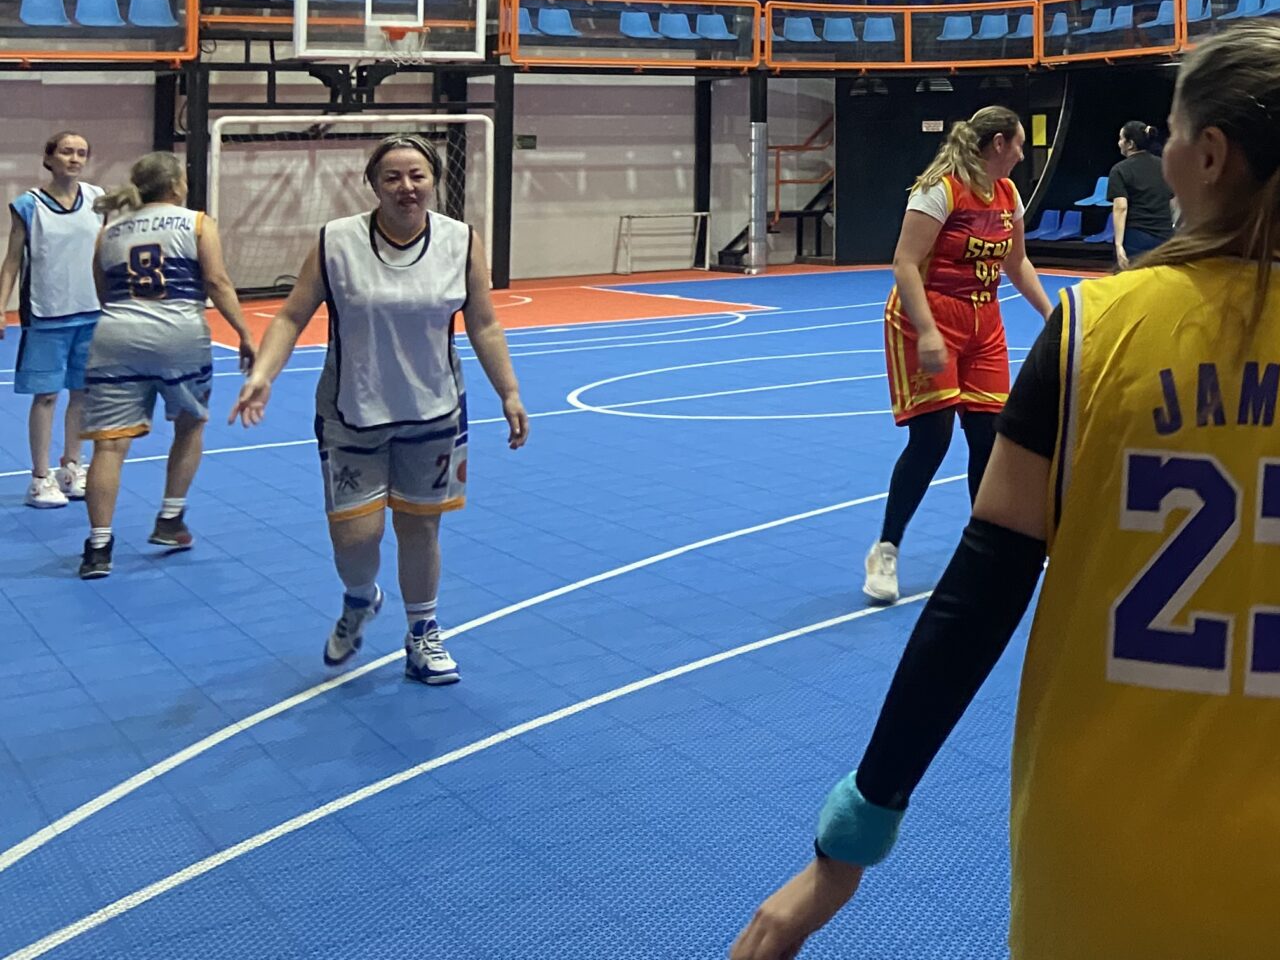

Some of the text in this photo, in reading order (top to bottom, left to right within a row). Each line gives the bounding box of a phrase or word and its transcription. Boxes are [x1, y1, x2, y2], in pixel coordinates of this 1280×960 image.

[151, 216, 191, 232] CAPITAL
[127, 242, 166, 299] 8
[432, 453, 450, 490] 2
